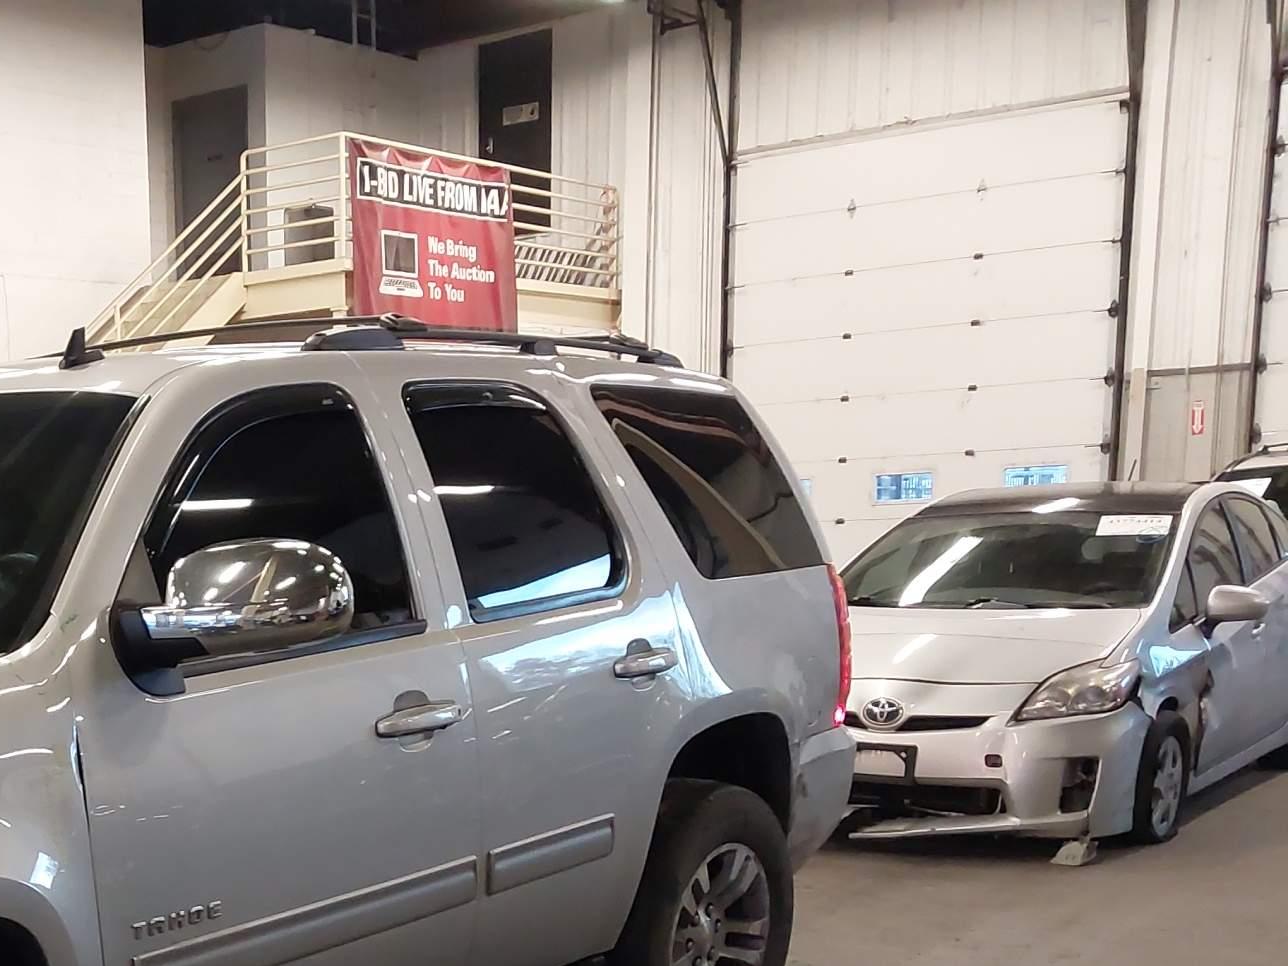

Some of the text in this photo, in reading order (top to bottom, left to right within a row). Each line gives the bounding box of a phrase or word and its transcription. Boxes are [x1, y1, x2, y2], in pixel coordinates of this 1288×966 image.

[403, 172, 435, 206] LIVE
[436, 179, 478, 214] FROM
[427, 235, 477, 262] We Bring
[427, 259, 495, 283] The Auction
[427, 282, 465, 303] To You
[131, 899, 223, 940] TAHOE
